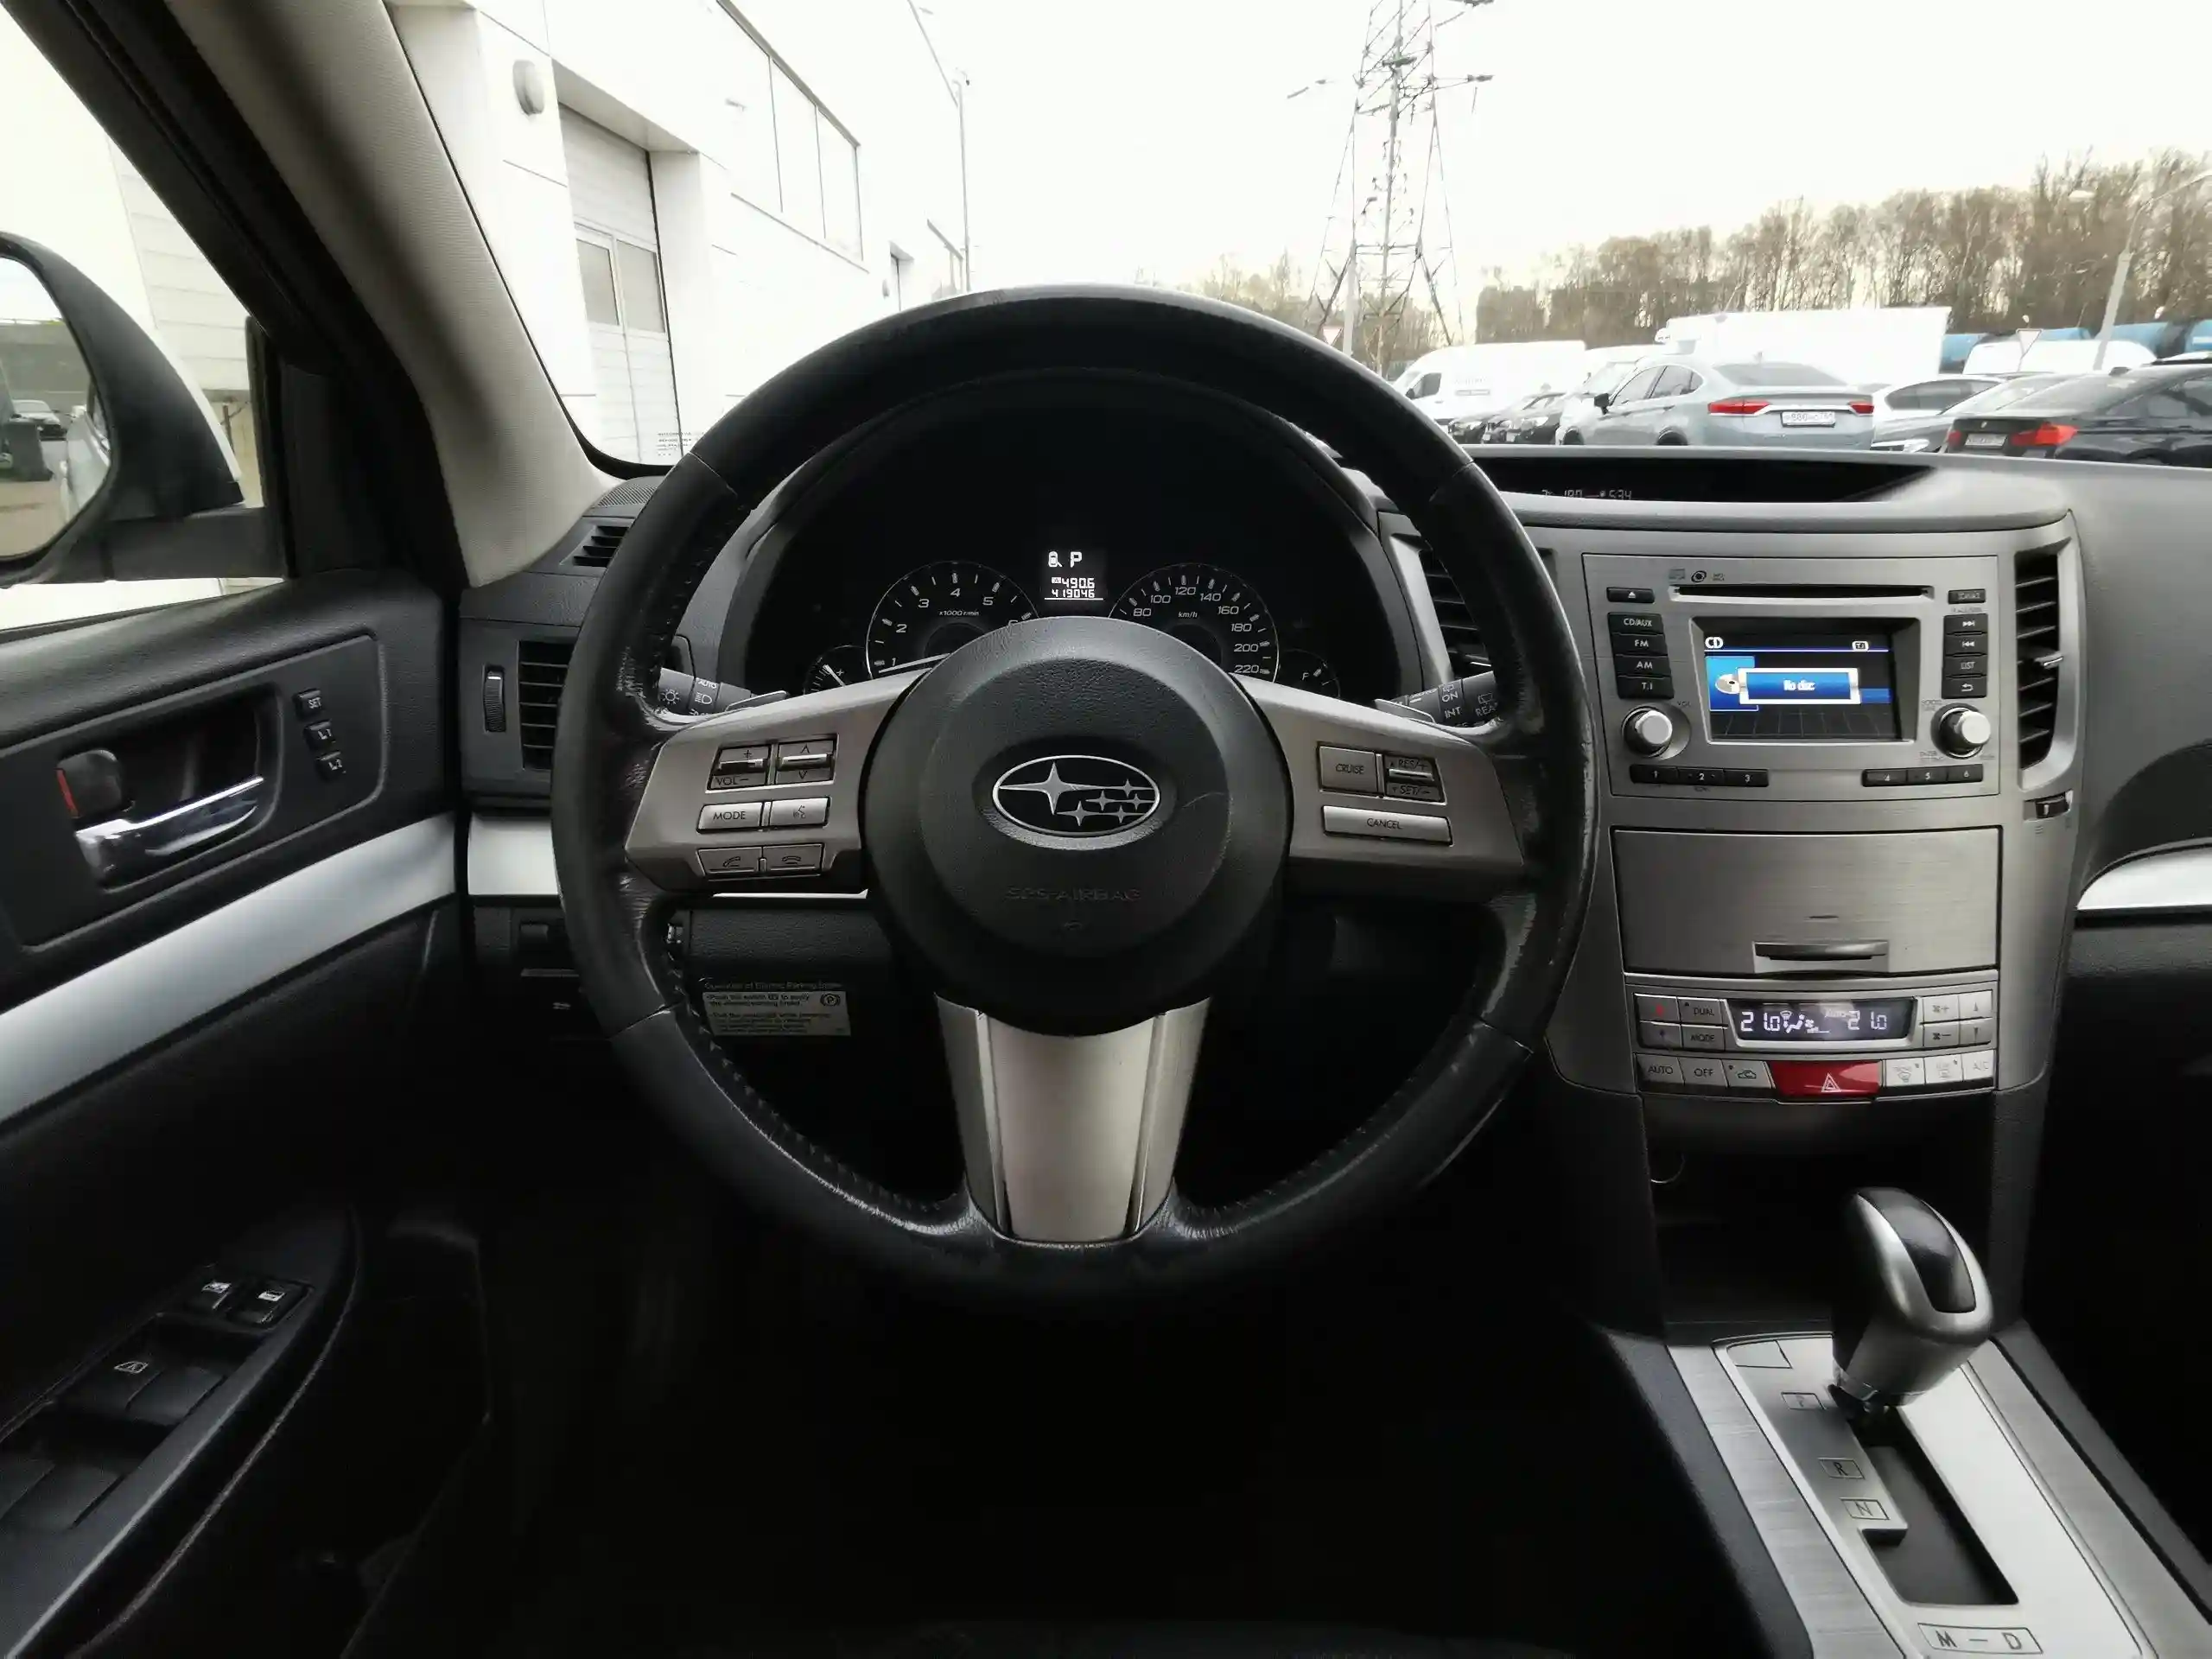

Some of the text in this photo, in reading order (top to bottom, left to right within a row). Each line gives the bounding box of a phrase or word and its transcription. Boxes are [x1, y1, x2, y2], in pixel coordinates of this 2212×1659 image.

[1071, 551, 1083, 568] P
[950, 588, 961, 597] 4
[1052, 589, 1095, 598] 419046
[1175, 587, 1196, 595] 120
[982, 596, 994, 606] 5
[1150, 595, 1171, 604] 100
[1200, 593, 1221, 601] 140
[918, 599, 930, 608] 3
[1133, 608, 1152, 617] 80
[1624, 618, 1653, 627] CD/AUX
[896, 624, 907, 633] 2
[1231, 623, 1252, 632] 180
[1705, 637, 1724, 648] CD
[1234, 644, 1259, 652] 200
[1234, 664, 1260, 674] 220
[1302, 672, 1309, 681] F
[698, 680, 717, 689] AUTO
[1442, 691, 1459, 702] ON
[1445, 706, 1461, 719] INT
[1336, 763, 1364, 774] CRUISE
[713, 810, 746, 820] MODE
[1367, 817, 1402, 830] CANCEL
[1648, 1065, 1673, 1074] AUTO
[1694, 1068, 1714, 1077] OFF
[1833, 1462, 1848, 1476] R
[1854, 1502, 1874, 1516] N
[1936, 1630, 2022, 1649] M D
